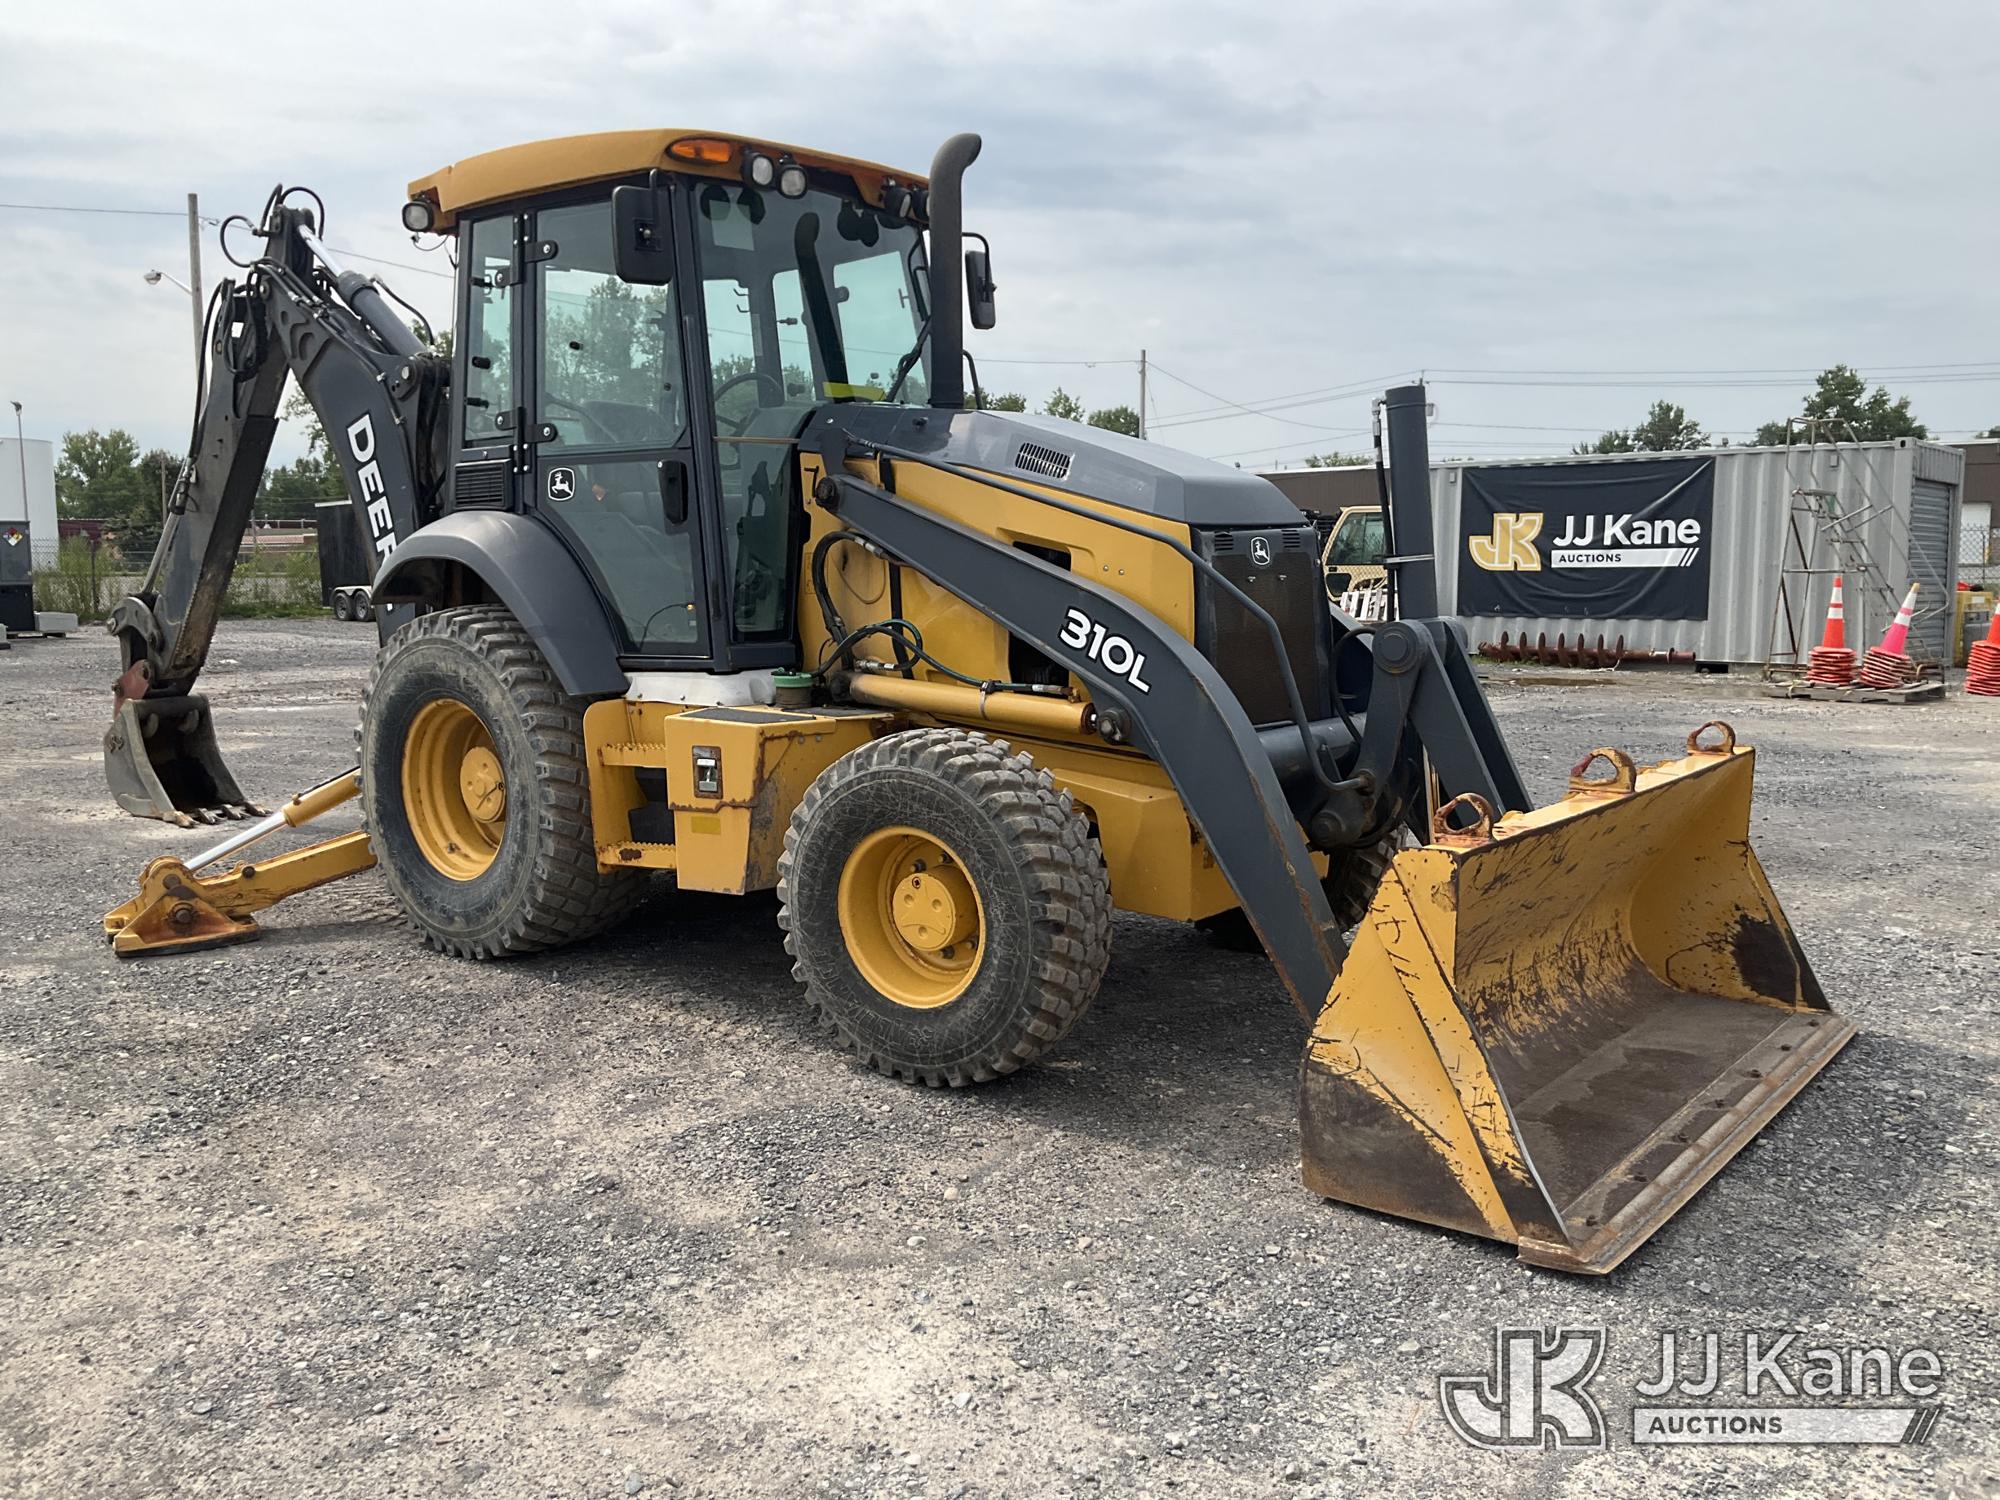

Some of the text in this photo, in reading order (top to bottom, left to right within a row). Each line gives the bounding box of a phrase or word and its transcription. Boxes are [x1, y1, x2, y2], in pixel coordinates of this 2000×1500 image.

[347, 414, 397, 611] DEER
[1553, 514, 1700, 546] JJ Kane
[1558, 553, 1622, 563] AUCTIONS
[1060, 608, 1150, 693] 310L
